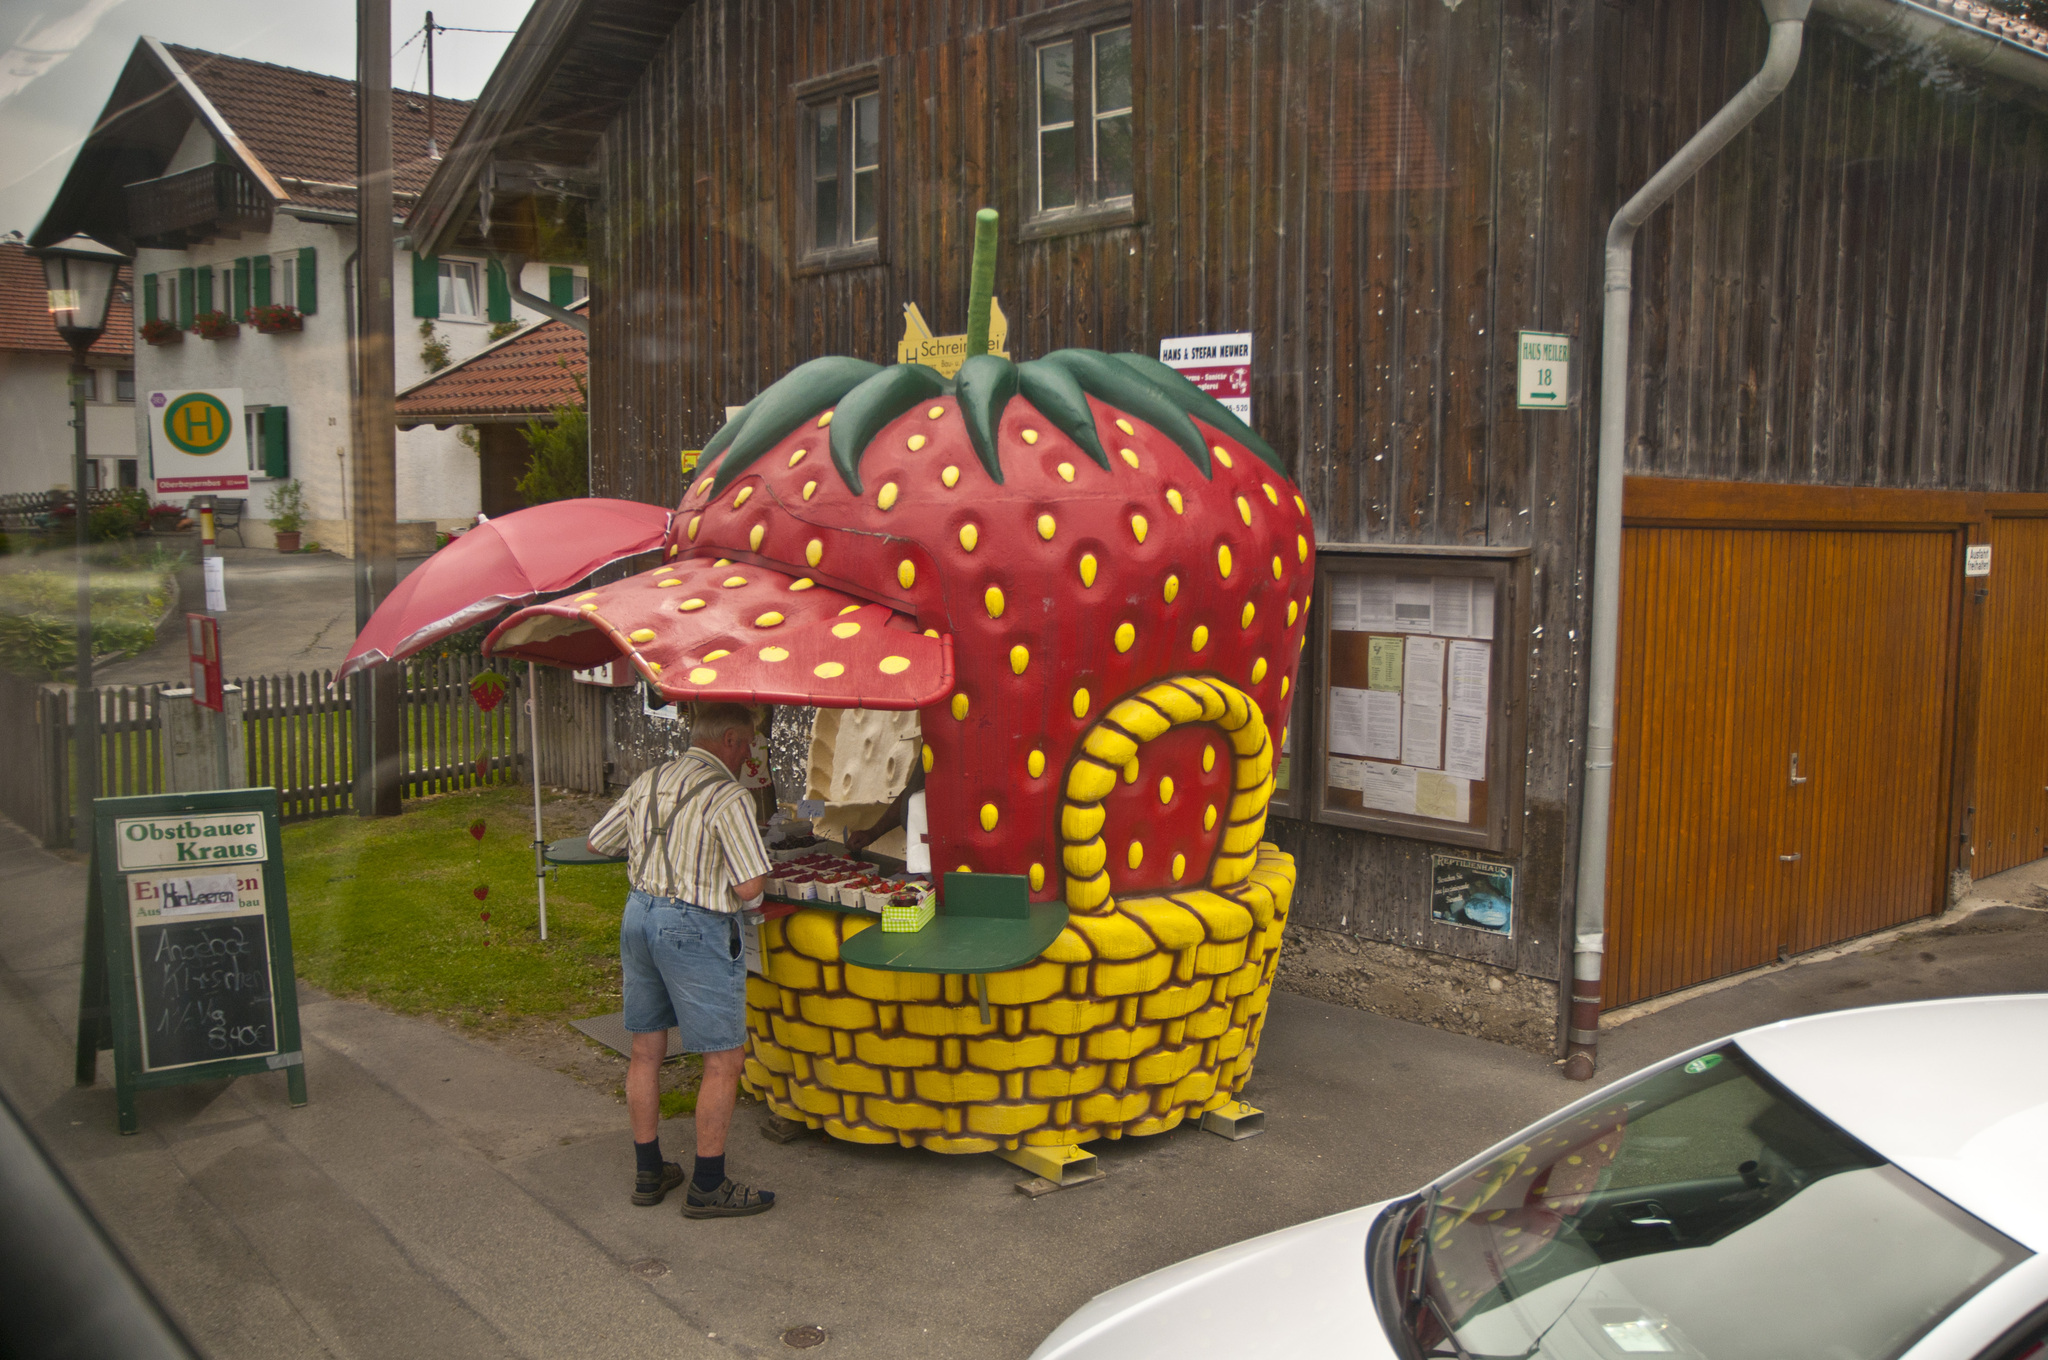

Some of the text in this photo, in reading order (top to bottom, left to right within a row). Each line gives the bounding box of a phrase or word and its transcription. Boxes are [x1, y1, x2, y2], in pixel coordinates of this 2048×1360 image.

[1163, 344, 1249, 361] HANS & STEFAN NEUNER
[1523, 343, 1568, 362] HAUS MEILER
[1537, 368, 1552, 386] 18
[182, 406, 213, 441] H
[125, 821, 256, 842] Obstbauer
[176, 841, 258, 862] Kraus
[155, 926, 250, 962] Angebot
